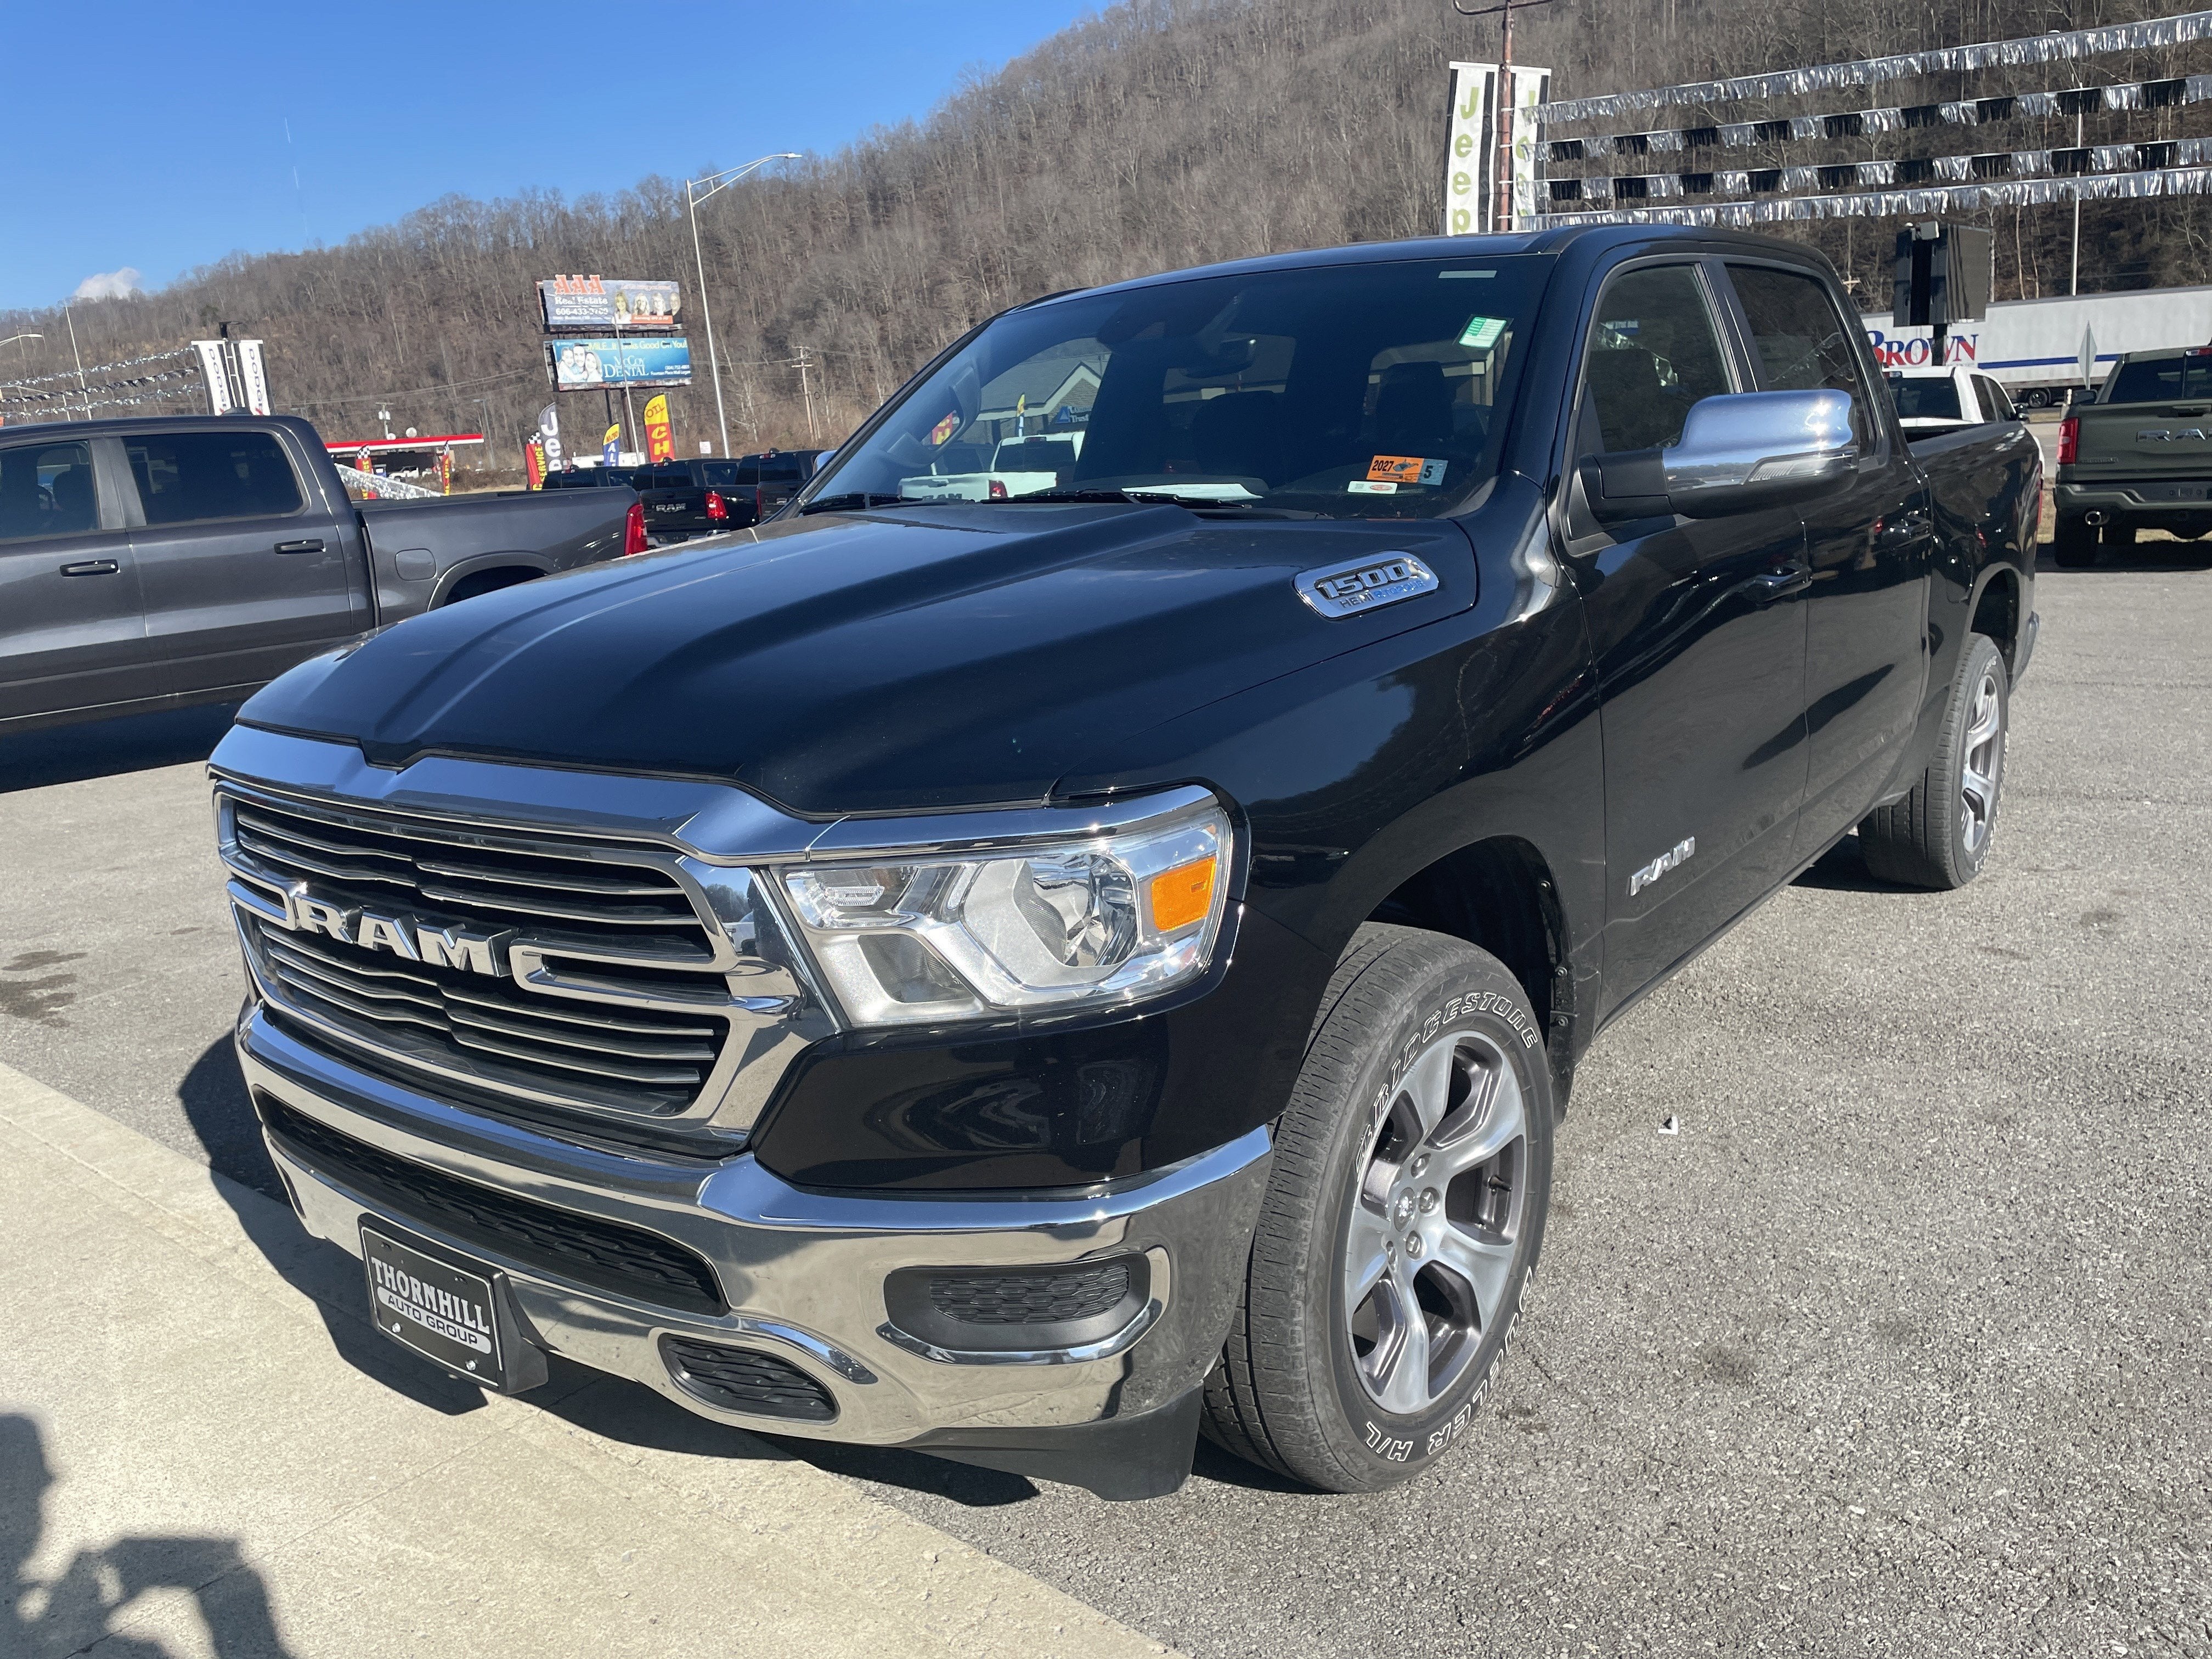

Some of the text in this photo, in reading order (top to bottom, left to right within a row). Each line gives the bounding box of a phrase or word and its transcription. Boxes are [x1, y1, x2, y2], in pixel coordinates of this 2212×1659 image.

[1453, 87, 1479, 234] Jeep
[554, 274, 606, 295] AAA
[578, 296, 608, 304] Estate
[646, 403, 665, 418] OIL
[2136, 427, 2212, 442] RA
[1372, 459, 1434, 479] 2027 5
[1317, 562, 1418, 600] 1500
[1338, 590, 1375, 608] HEMI
[1626, 836, 1696, 896] RAM
[294, 892, 510, 978] RAM
[1355, 991, 1538, 1183] BRIDGESTONE
[371, 1256, 490, 1334] THORNHILL
[388, 1295, 478, 1345] AUTO GROUP
[1365, 1265, 1534, 1462] DUELER H/L
